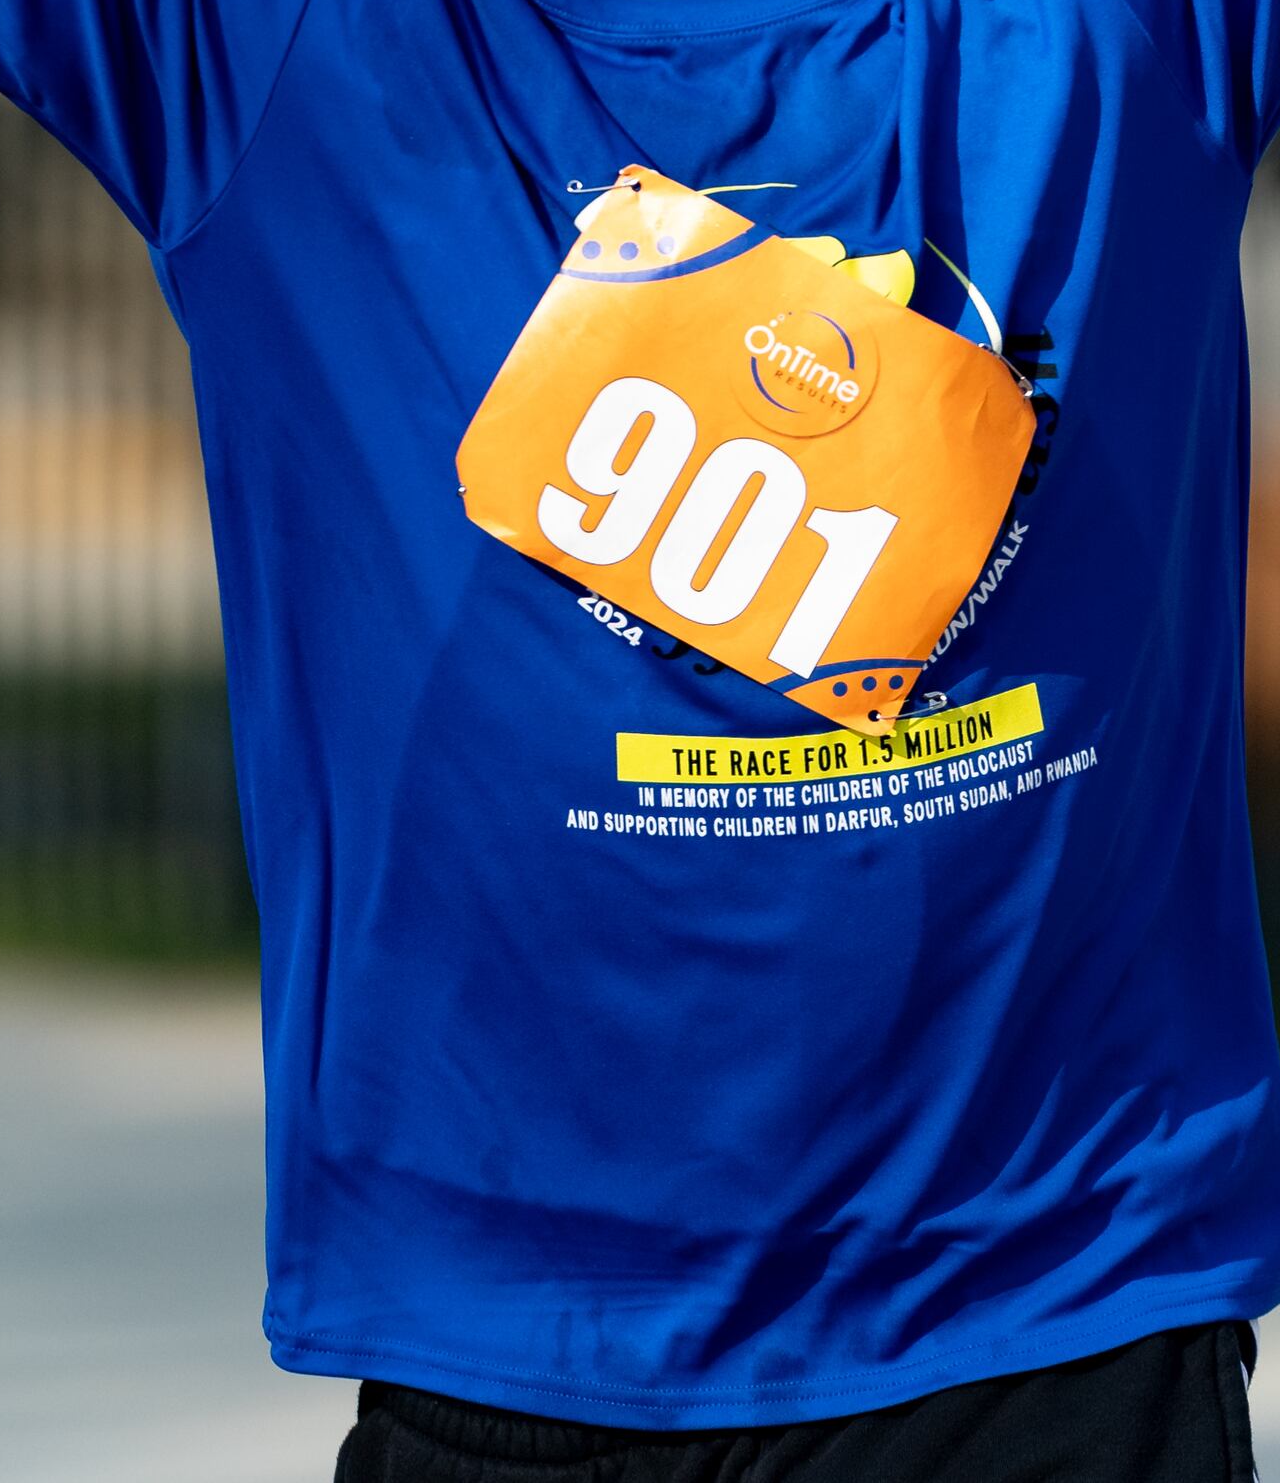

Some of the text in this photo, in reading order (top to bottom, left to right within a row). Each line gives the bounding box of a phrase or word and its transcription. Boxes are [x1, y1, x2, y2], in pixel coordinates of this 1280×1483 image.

[744, 324, 860, 403] OnTime
[774, 370, 848, 414] RESULTS
[536, 376, 900, 680] 901
[577, 588, 644, 646] 2024
[638, 741, 1034, 808] IN MEMORY OF THE CHILDREN OF THE HOLOCAUST
[672, 711, 994, 776] THE RACE FOR 1.5 MILLION
[566, 746, 1098, 837] AND SUPPORTING CHILDREN IN DARFUR, SOUTH SUDAN, AND RWANDA
